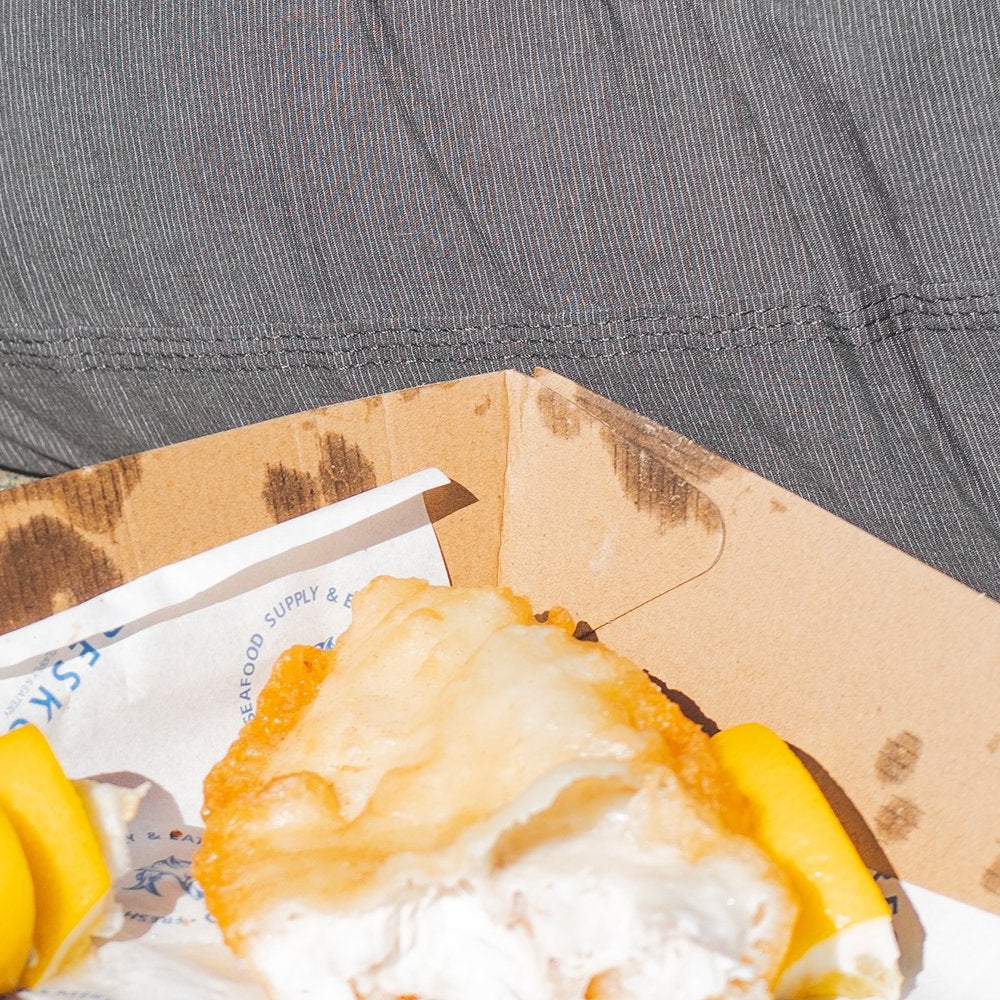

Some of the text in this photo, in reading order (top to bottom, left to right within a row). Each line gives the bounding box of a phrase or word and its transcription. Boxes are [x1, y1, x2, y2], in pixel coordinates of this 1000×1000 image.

[264, 585, 319, 628] SUPPLY
[326, 587, 338, 602] &
[147, 831, 160, 840] &
